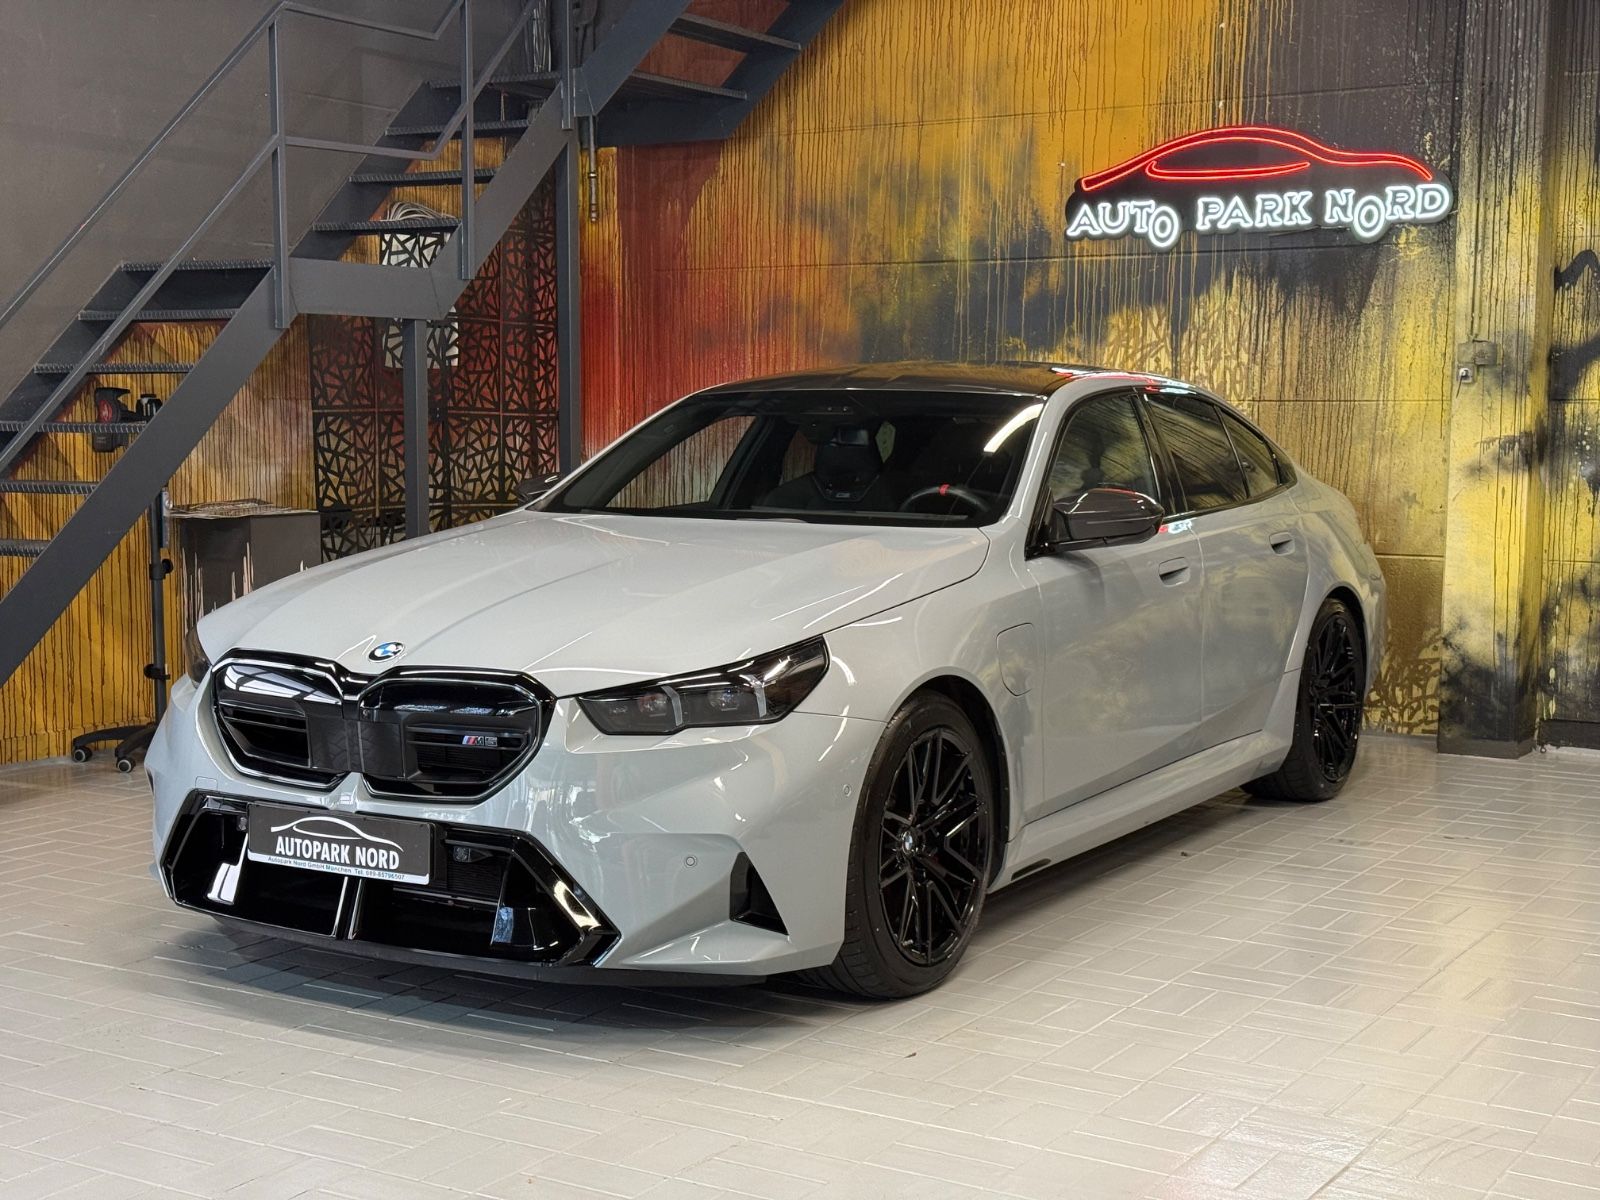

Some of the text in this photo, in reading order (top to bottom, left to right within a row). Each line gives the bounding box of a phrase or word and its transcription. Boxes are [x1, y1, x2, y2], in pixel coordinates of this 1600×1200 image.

[1066, 183, 1451, 248] AUTO PARK NORD
[267, 856, 292, 866] Autopark
[293, 860, 307, 868] Nord
[307, 862, 325, 870] GmbH
[275, 835, 400, 870] AUTOPARK NORD
